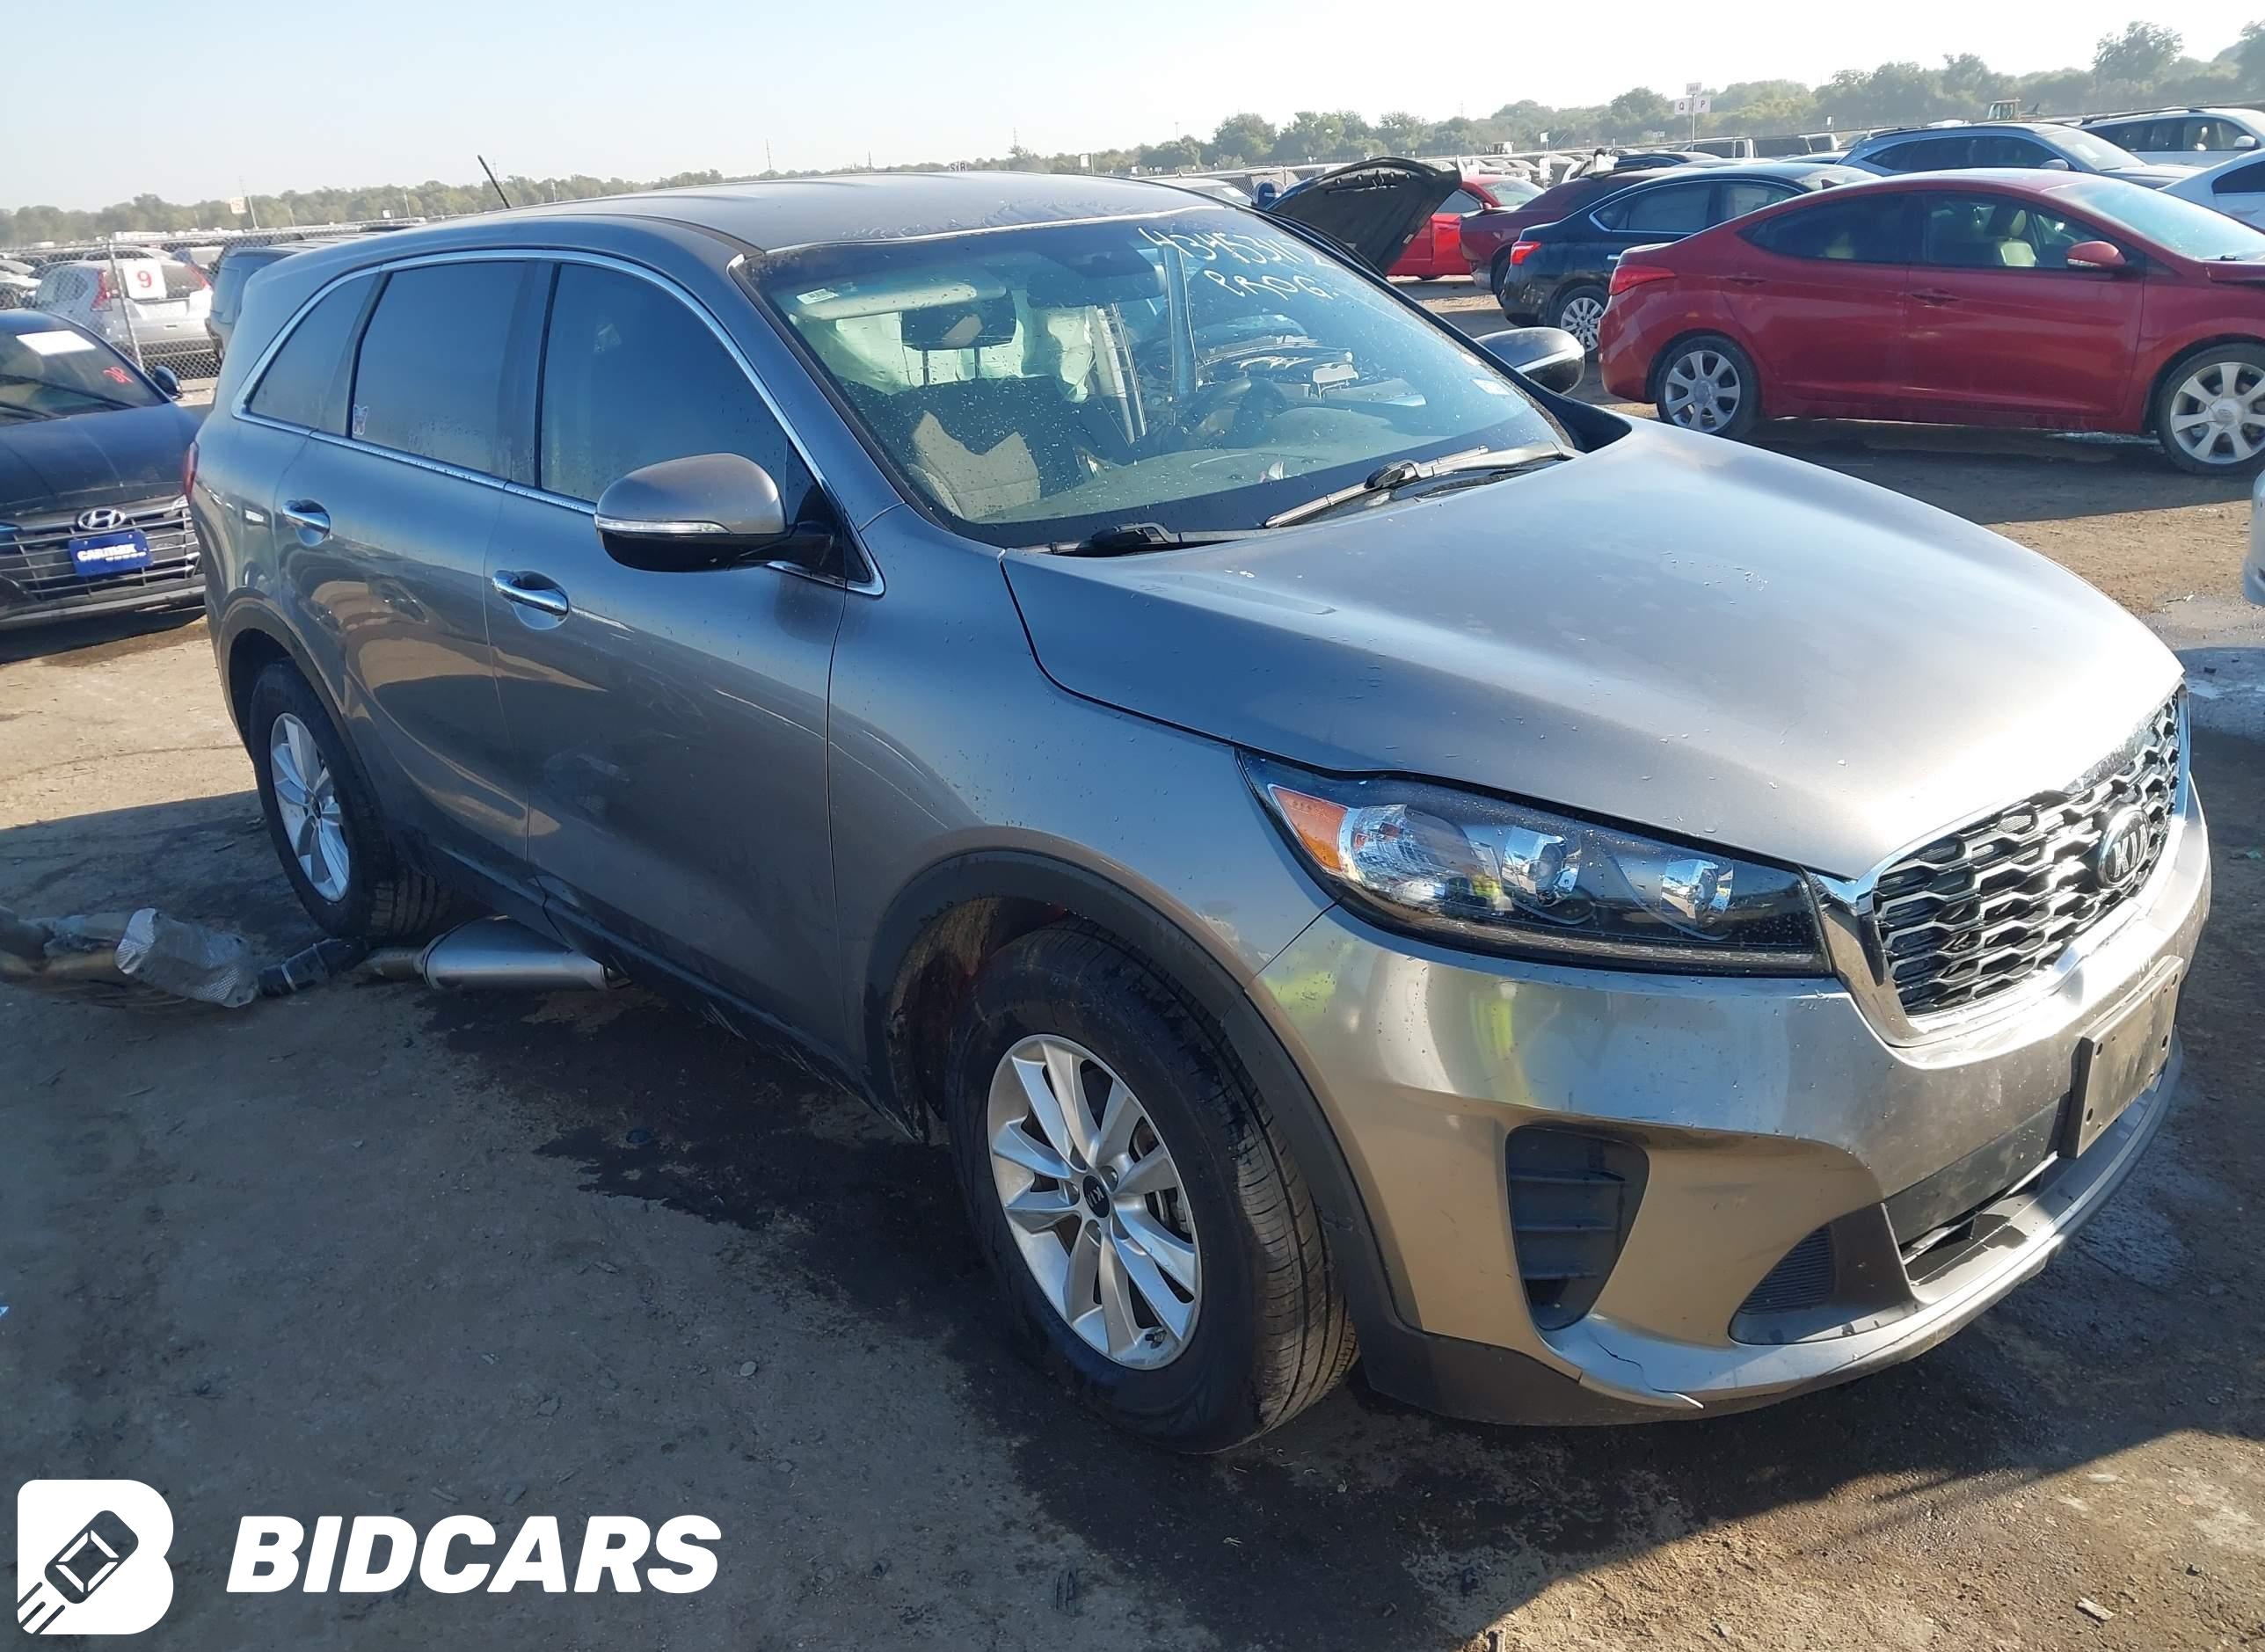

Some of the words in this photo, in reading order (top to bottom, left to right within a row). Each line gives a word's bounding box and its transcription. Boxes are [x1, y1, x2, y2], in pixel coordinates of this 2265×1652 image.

[136, 270, 152, 289] 9
[2112, 823, 2148, 878] KIA
[1085, 1185, 1105, 1209] KIA
